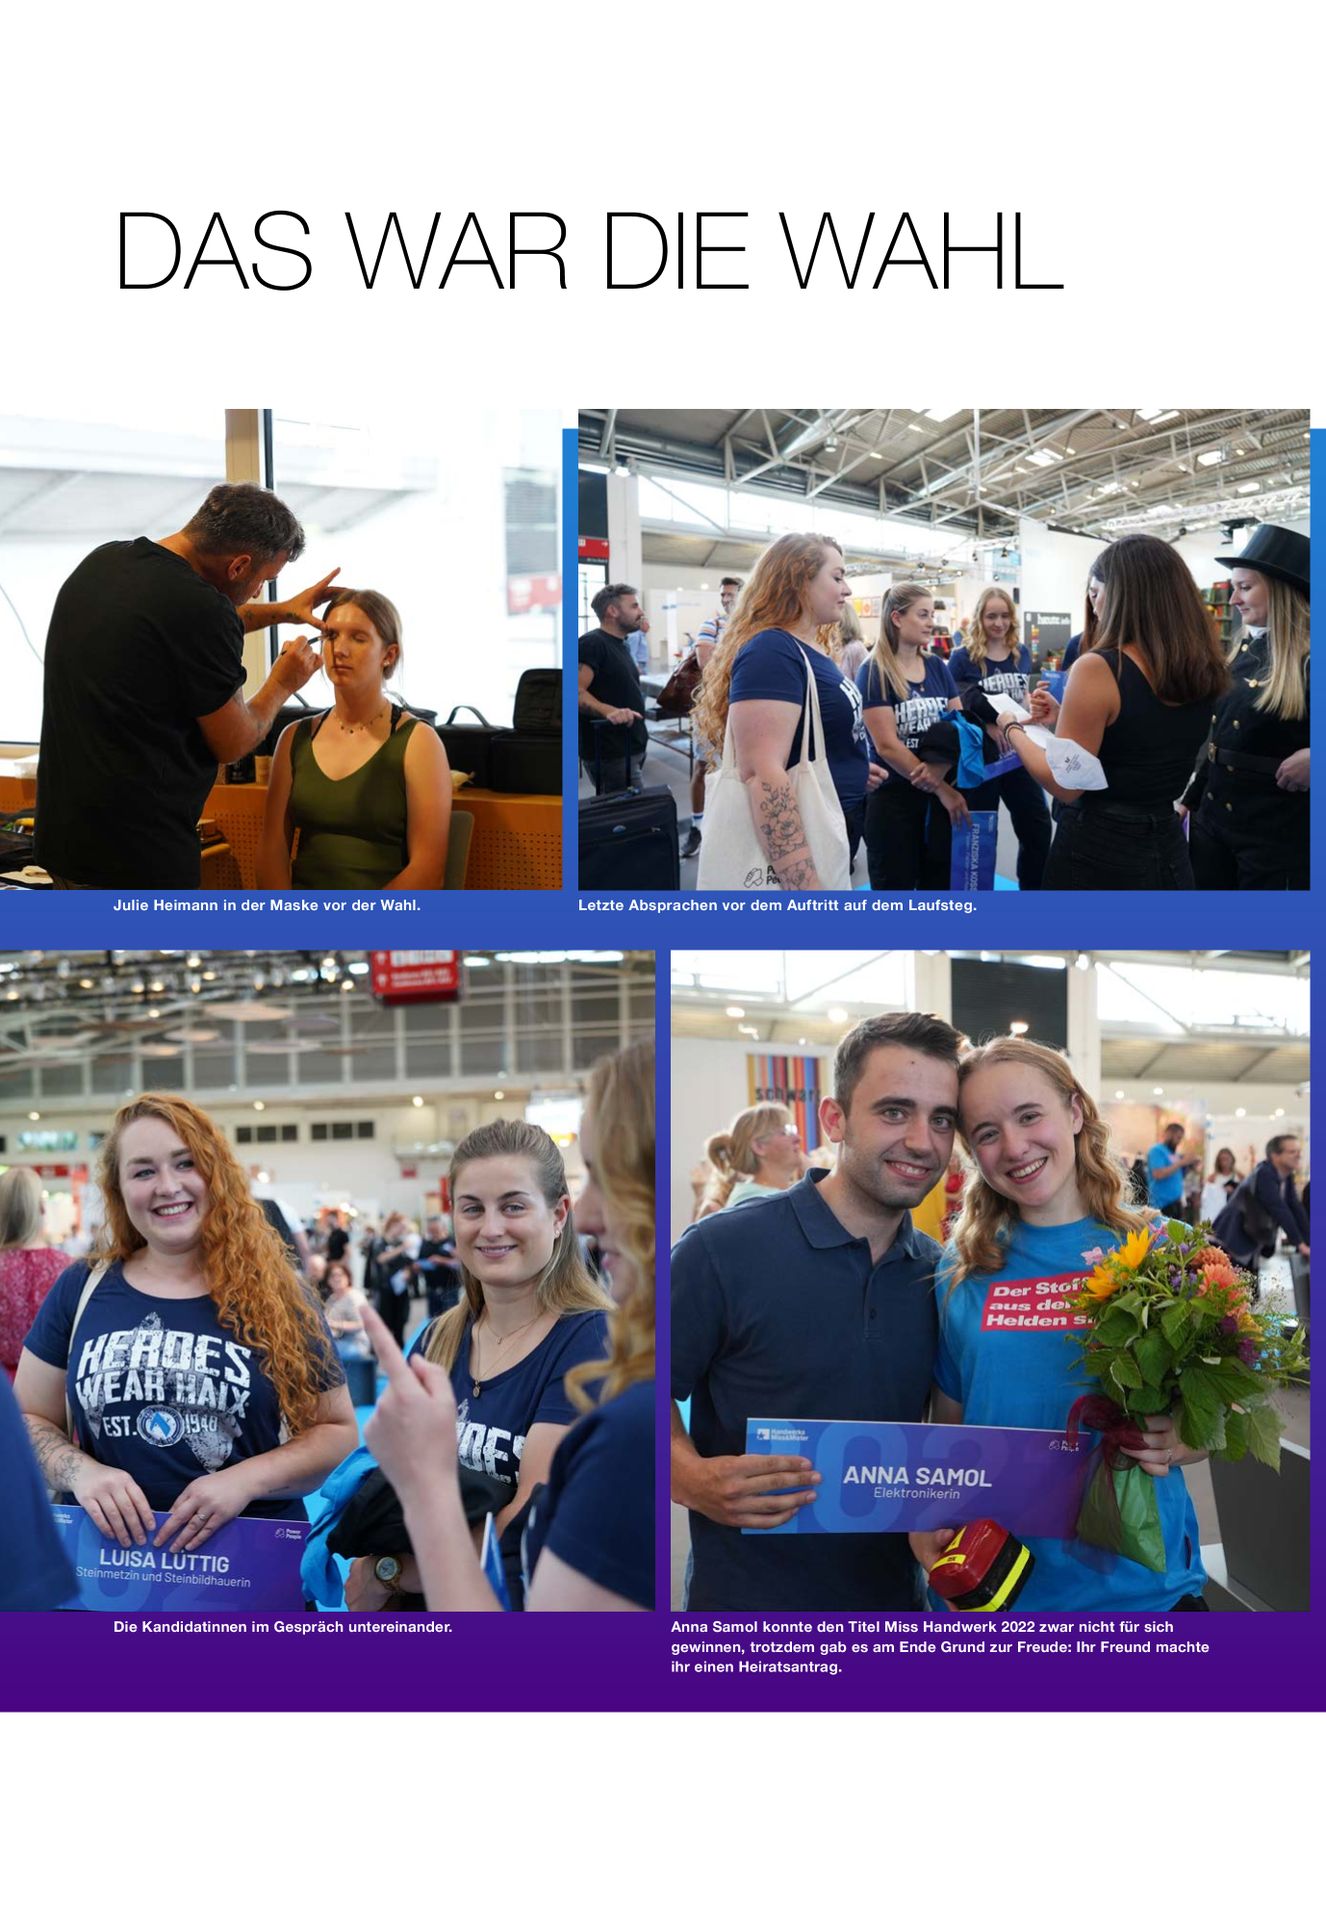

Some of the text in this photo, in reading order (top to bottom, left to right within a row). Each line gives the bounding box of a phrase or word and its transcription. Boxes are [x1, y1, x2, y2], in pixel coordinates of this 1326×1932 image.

[993, 1286, 1031, 1297] Der
[989, 1303, 1031, 1311] aus
[986, 1314, 1068, 1327] Helden
[76, 1330, 252, 1389] HEROES
[75, 1370, 251, 1419] WEAR HAIX
[102, 1416, 138, 1437] EST.
[843, 1465, 993, 1488] ANNA SAMOL
[873, 1486, 961, 1500] Elektronikerin
[99, 1548, 231, 1573] LUISA LÜTTIG
[75, 1567, 251, 1588] Steinmetzin und Steinbildhauerin
